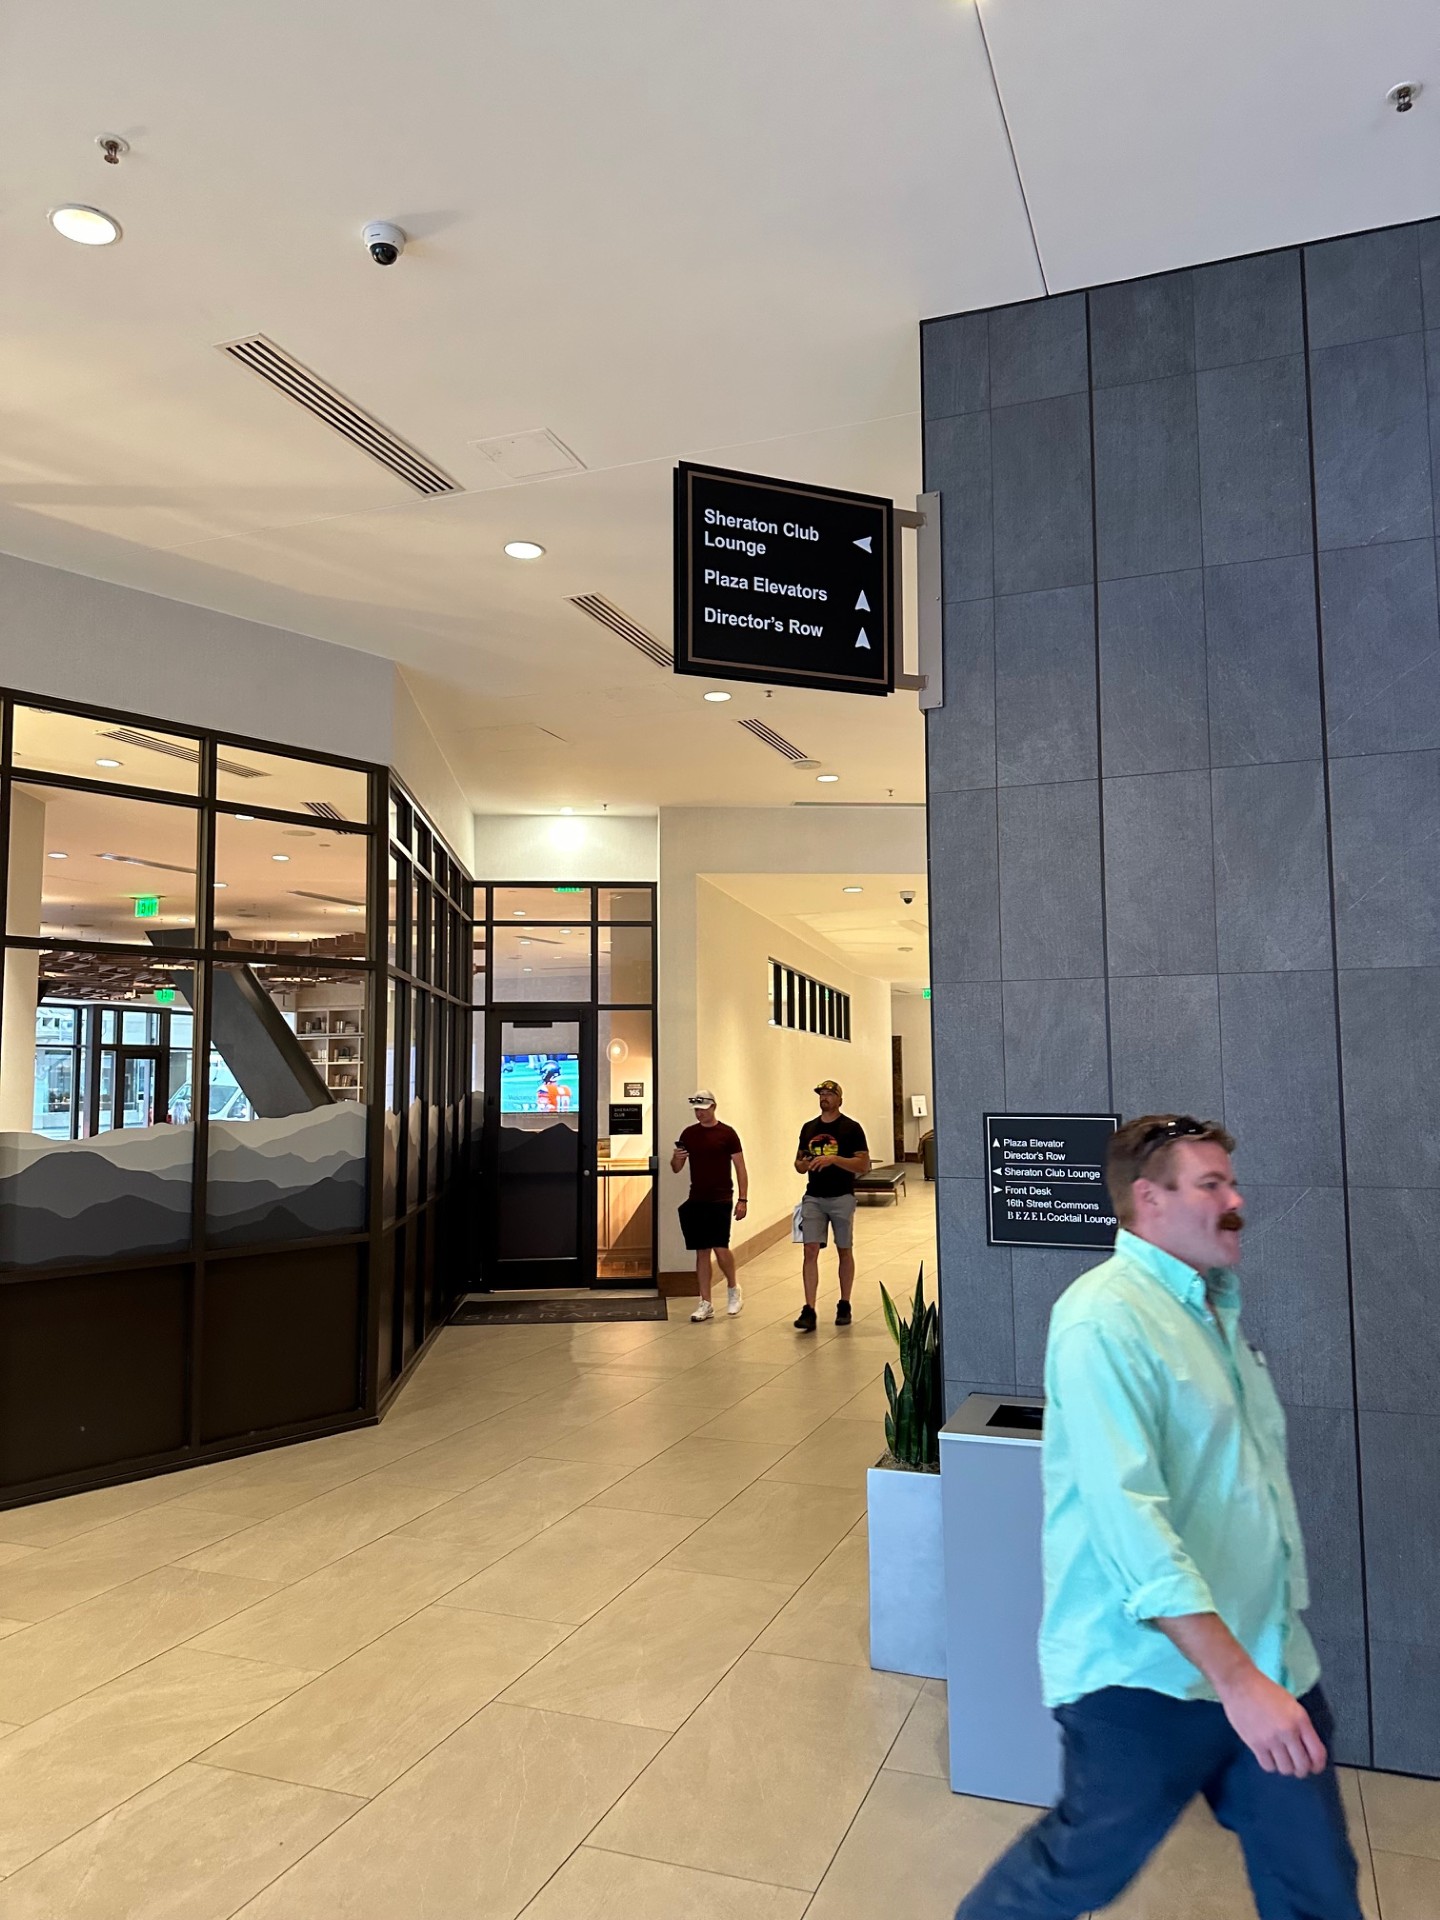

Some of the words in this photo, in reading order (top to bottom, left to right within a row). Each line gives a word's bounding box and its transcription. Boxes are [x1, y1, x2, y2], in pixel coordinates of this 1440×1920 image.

[704, 508, 778, 535] Sheraton
[783, 522, 819, 542] Club
[704, 531, 767, 557] Lounge
[704, 569, 748, 590] Plaza
[753, 576, 828, 601] Elevators
[704, 607, 784, 632] Director's
[789, 619, 824, 637] Row
[1003, 1138, 1028, 1148] Plaza
[1029, 1139, 1065, 1148] Elevator
[1003, 1150, 1044, 1161] Director's
[1045, 1151, 1066, 1161] Row
[1004, 1167, 1043, 1177] Sheraton
[1045, 1168, 1066, 1178] Club
[1067, 1169, 1101, 1181] Lounge
[1004, 1186, 1028, 1195] Front
[1029, 1186, 1052, 1196] Desk
[1006, 1199, 1024, 1208] 16th
[1026, 1200, 1052, 1209] Street
[1053, 1200, 1100, 1211] Commons
[1007, 1211, 1047, 1221] BEZEL
[1046, 1212, 1082, 1223] Cocktail
[1084, 1213, 1117, 1226] Lounge
